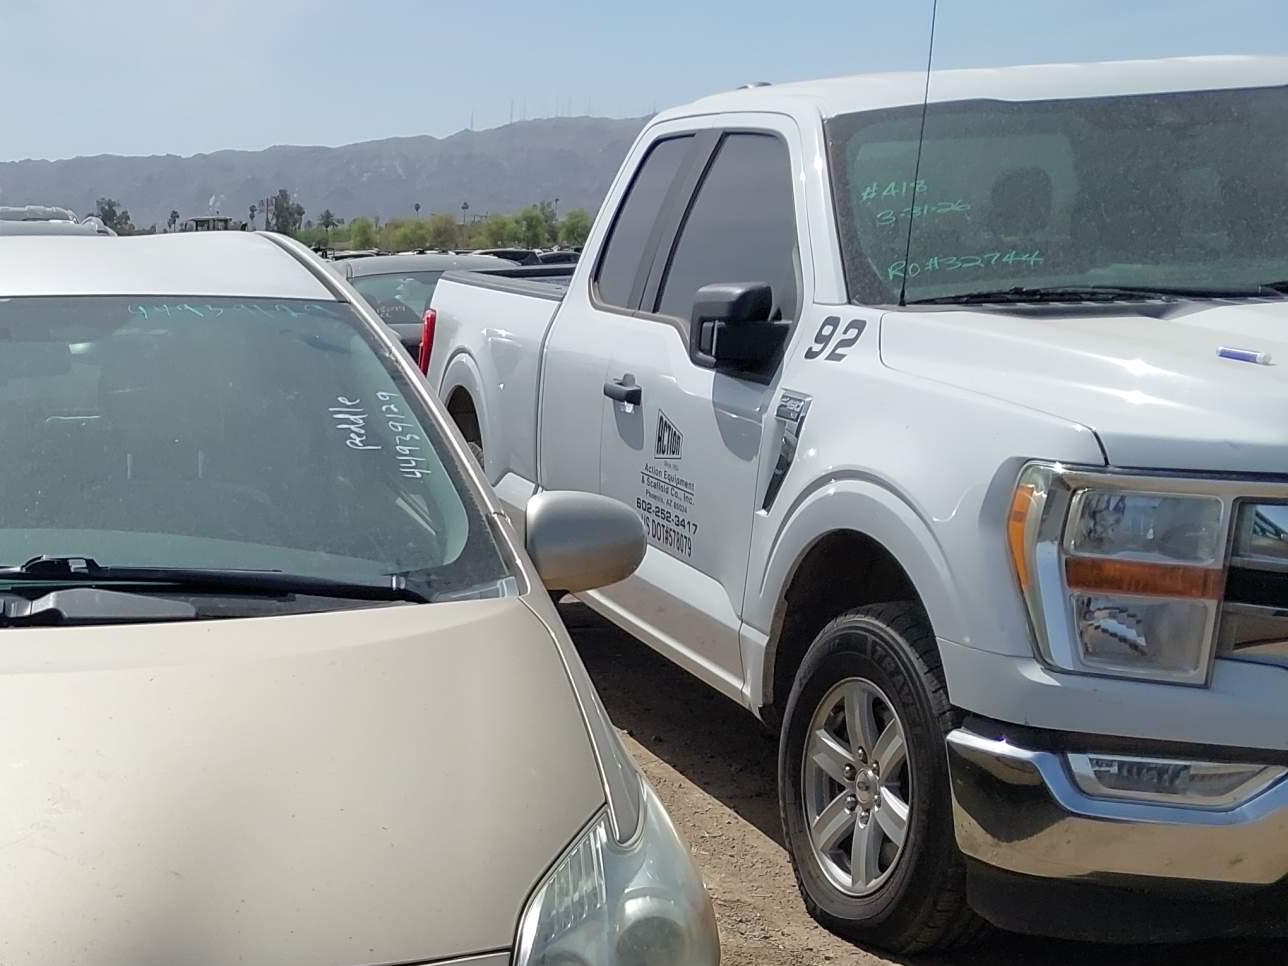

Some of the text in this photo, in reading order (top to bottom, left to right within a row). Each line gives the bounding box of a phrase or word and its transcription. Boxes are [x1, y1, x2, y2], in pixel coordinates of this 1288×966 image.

[804, 316, 867, 362] 92
[375, 390, 432, 480] 44939129
[644, 463, 663, 478] Action
[663, 470, 695, 491] Equipment
[646, 477, 670, 494] Scaffold
[683, 493, 695, 506] Inc.
[636, 497, 698, 535] 602-252-3417
